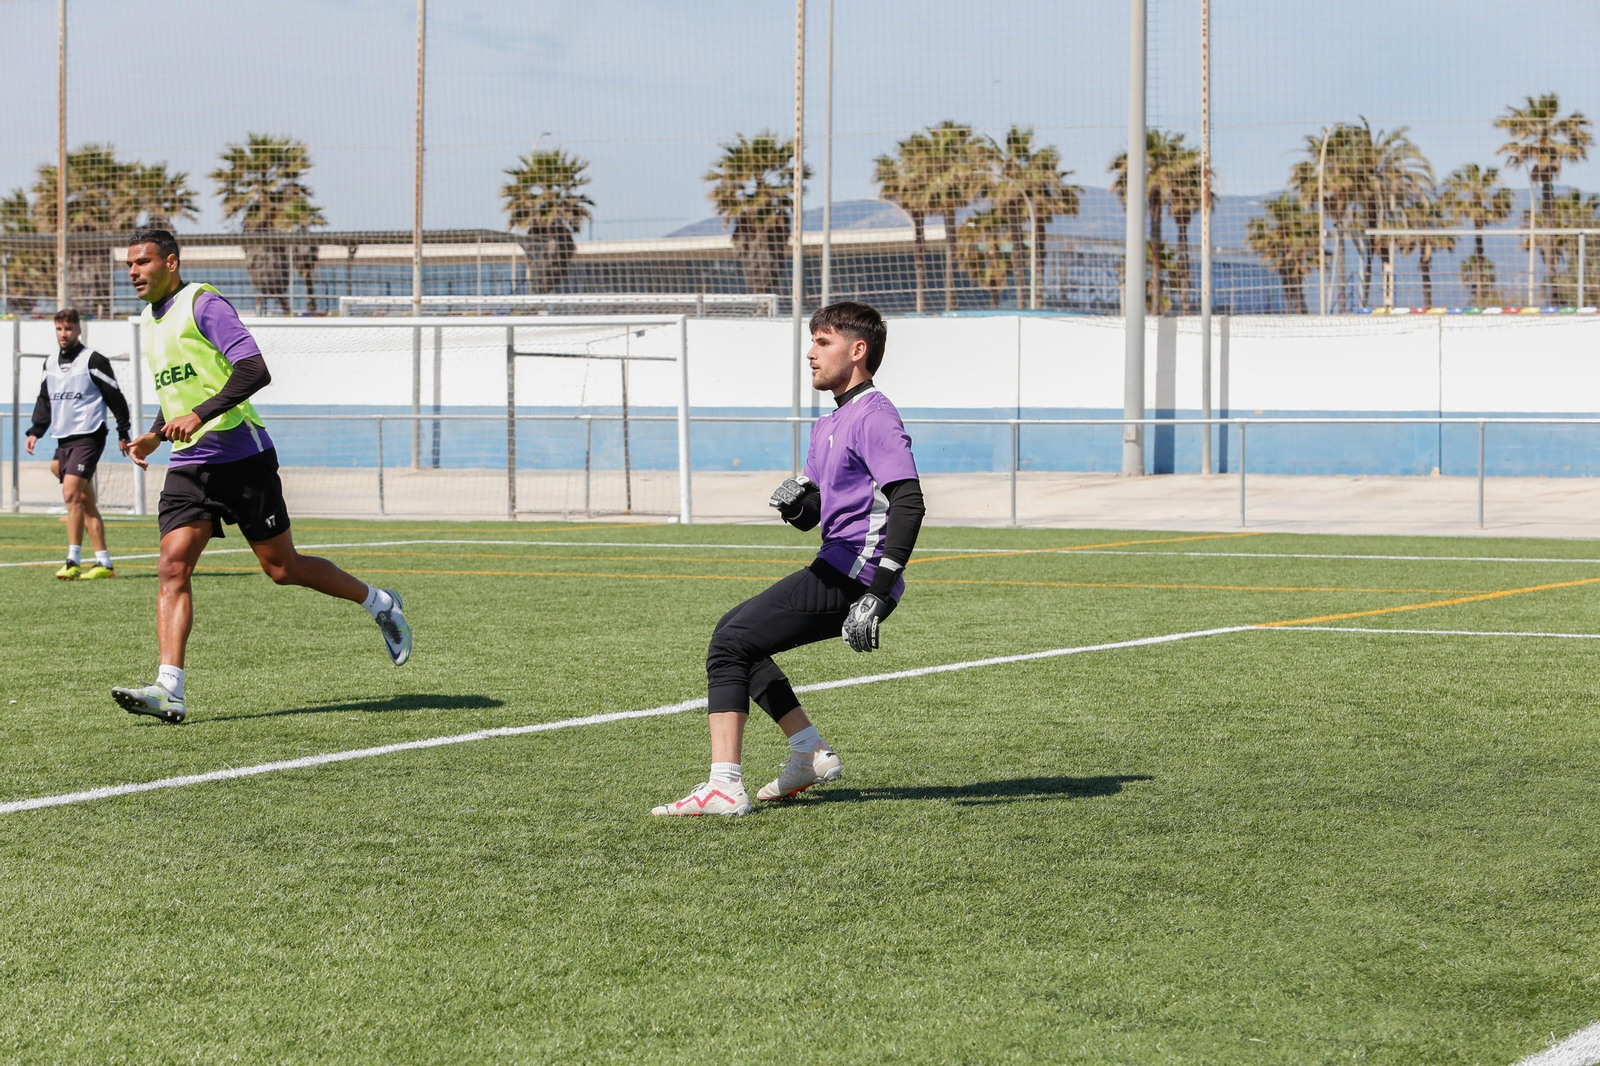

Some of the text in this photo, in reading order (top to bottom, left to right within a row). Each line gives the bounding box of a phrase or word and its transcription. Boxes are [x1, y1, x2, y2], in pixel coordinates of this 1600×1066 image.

[154, 362, 198, 391] EGEA
[828, 434, 834, 449] 1
[265, 514, 276, 529] 17
